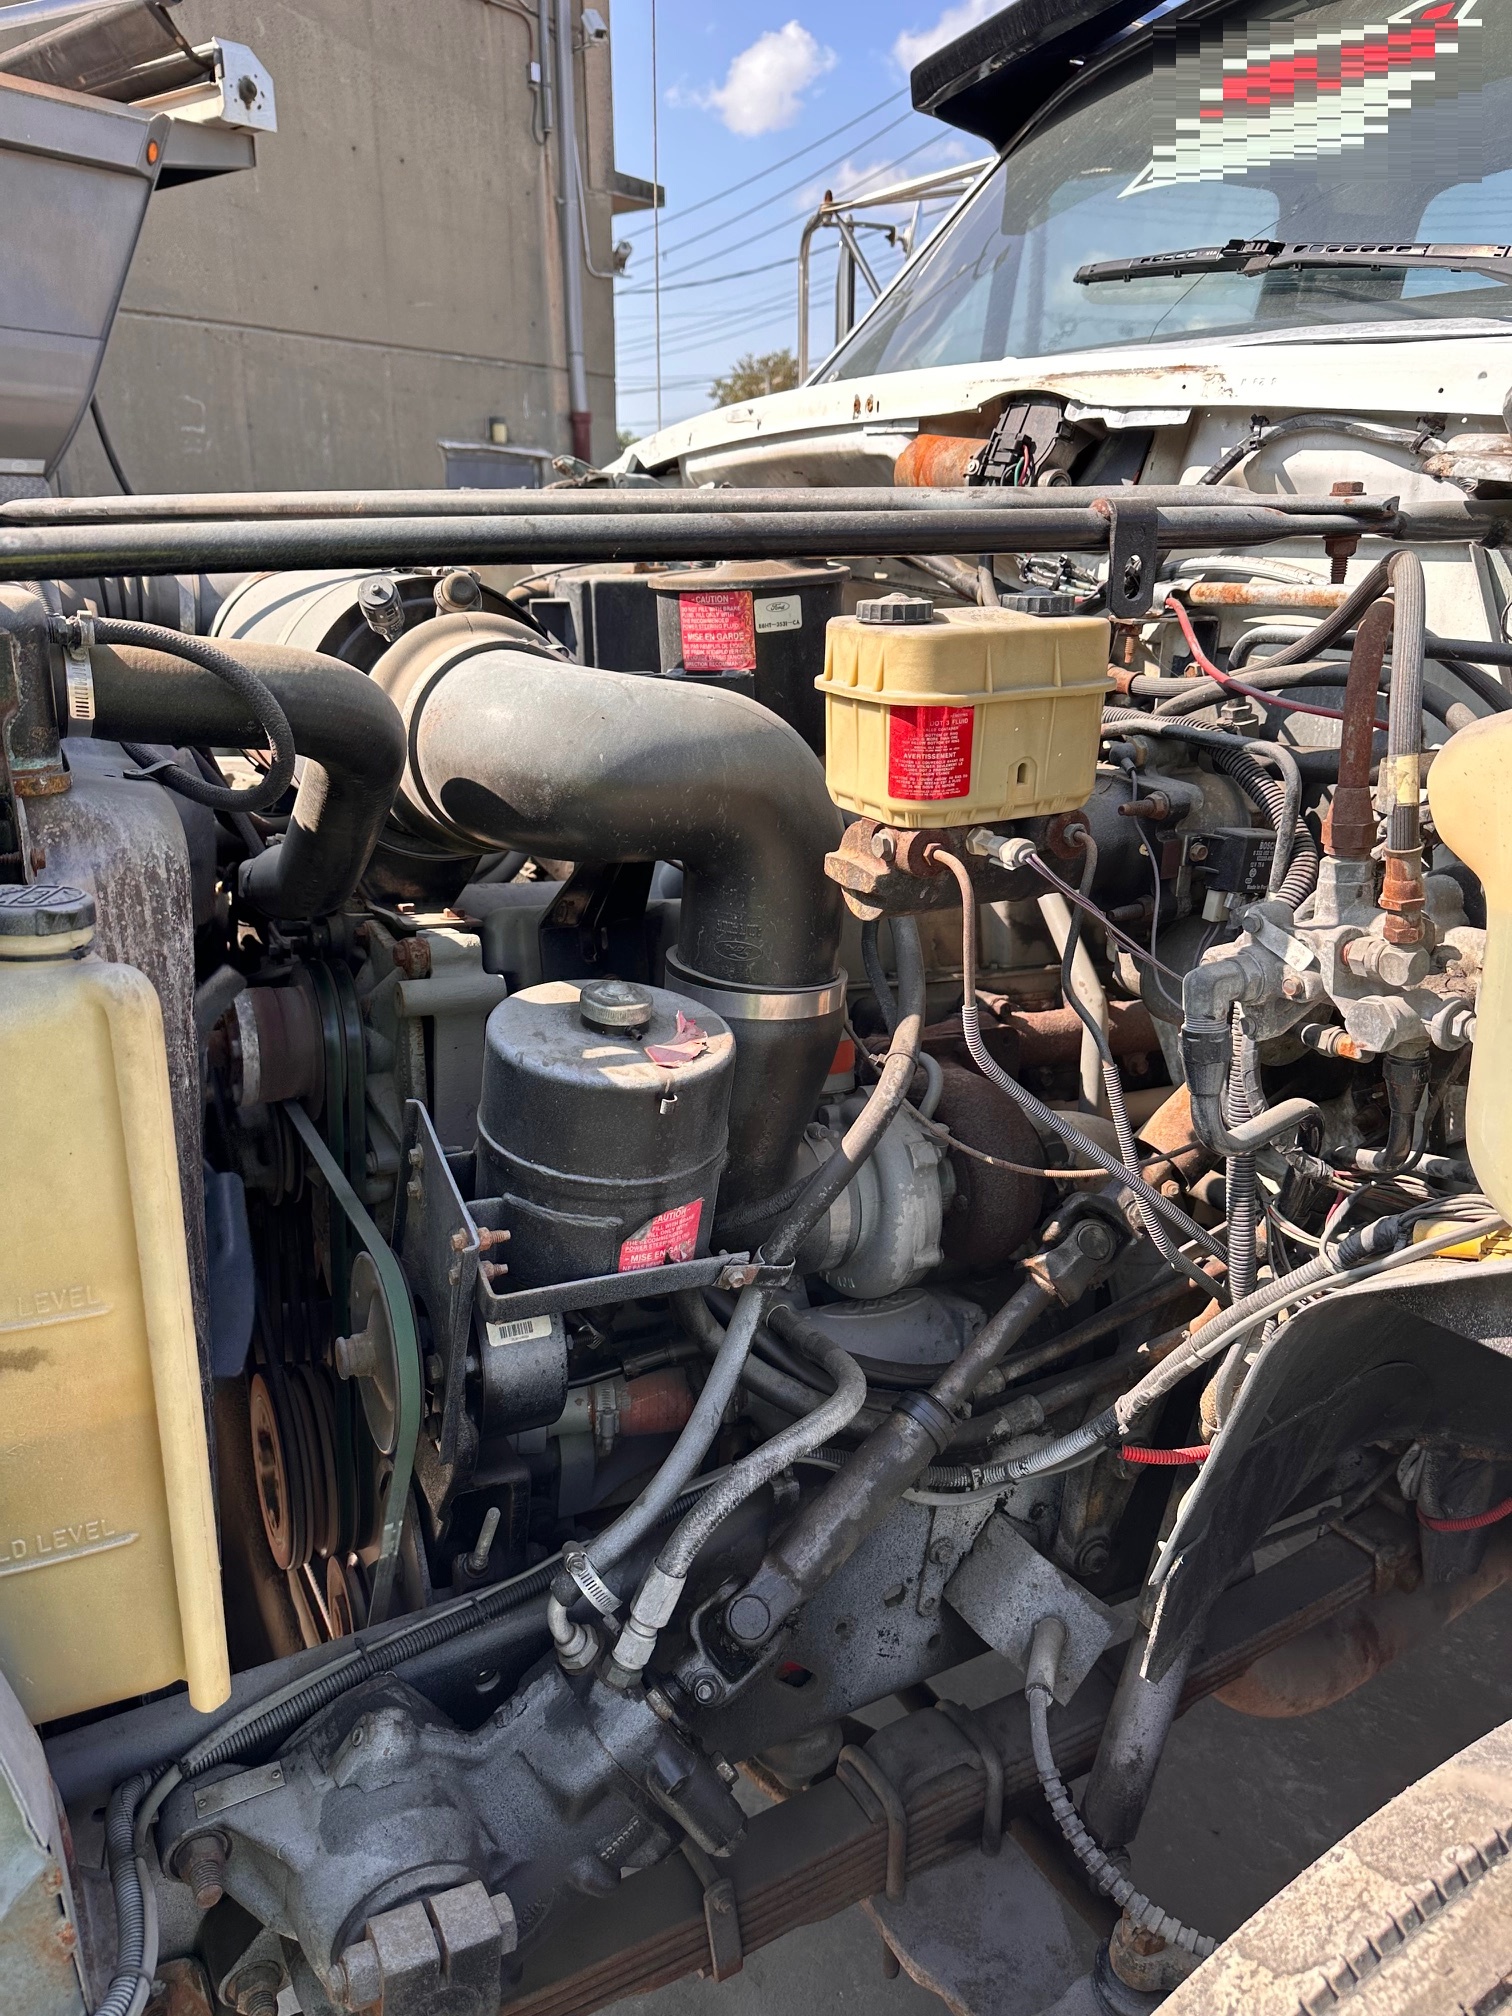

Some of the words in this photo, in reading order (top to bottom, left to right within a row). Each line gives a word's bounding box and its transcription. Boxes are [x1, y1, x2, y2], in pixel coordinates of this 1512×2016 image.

[696, 595, 729, 604] CAUTION
[687, 633, 703, 642] MISE
[705, 633, 715, 642] EN
[716, 632, 745, 642] GARDE
[904, 752, 957, 760] AVERTISSEMENT
[625, 1244, 647, 1252] POWER
[631, 1253, 653, 1263] MISE
[655, 1249, 666, 1258] EN
[17, 1285, 101, 1317] LEVEL
[36, 1519, 115, 1553] LEVEL
